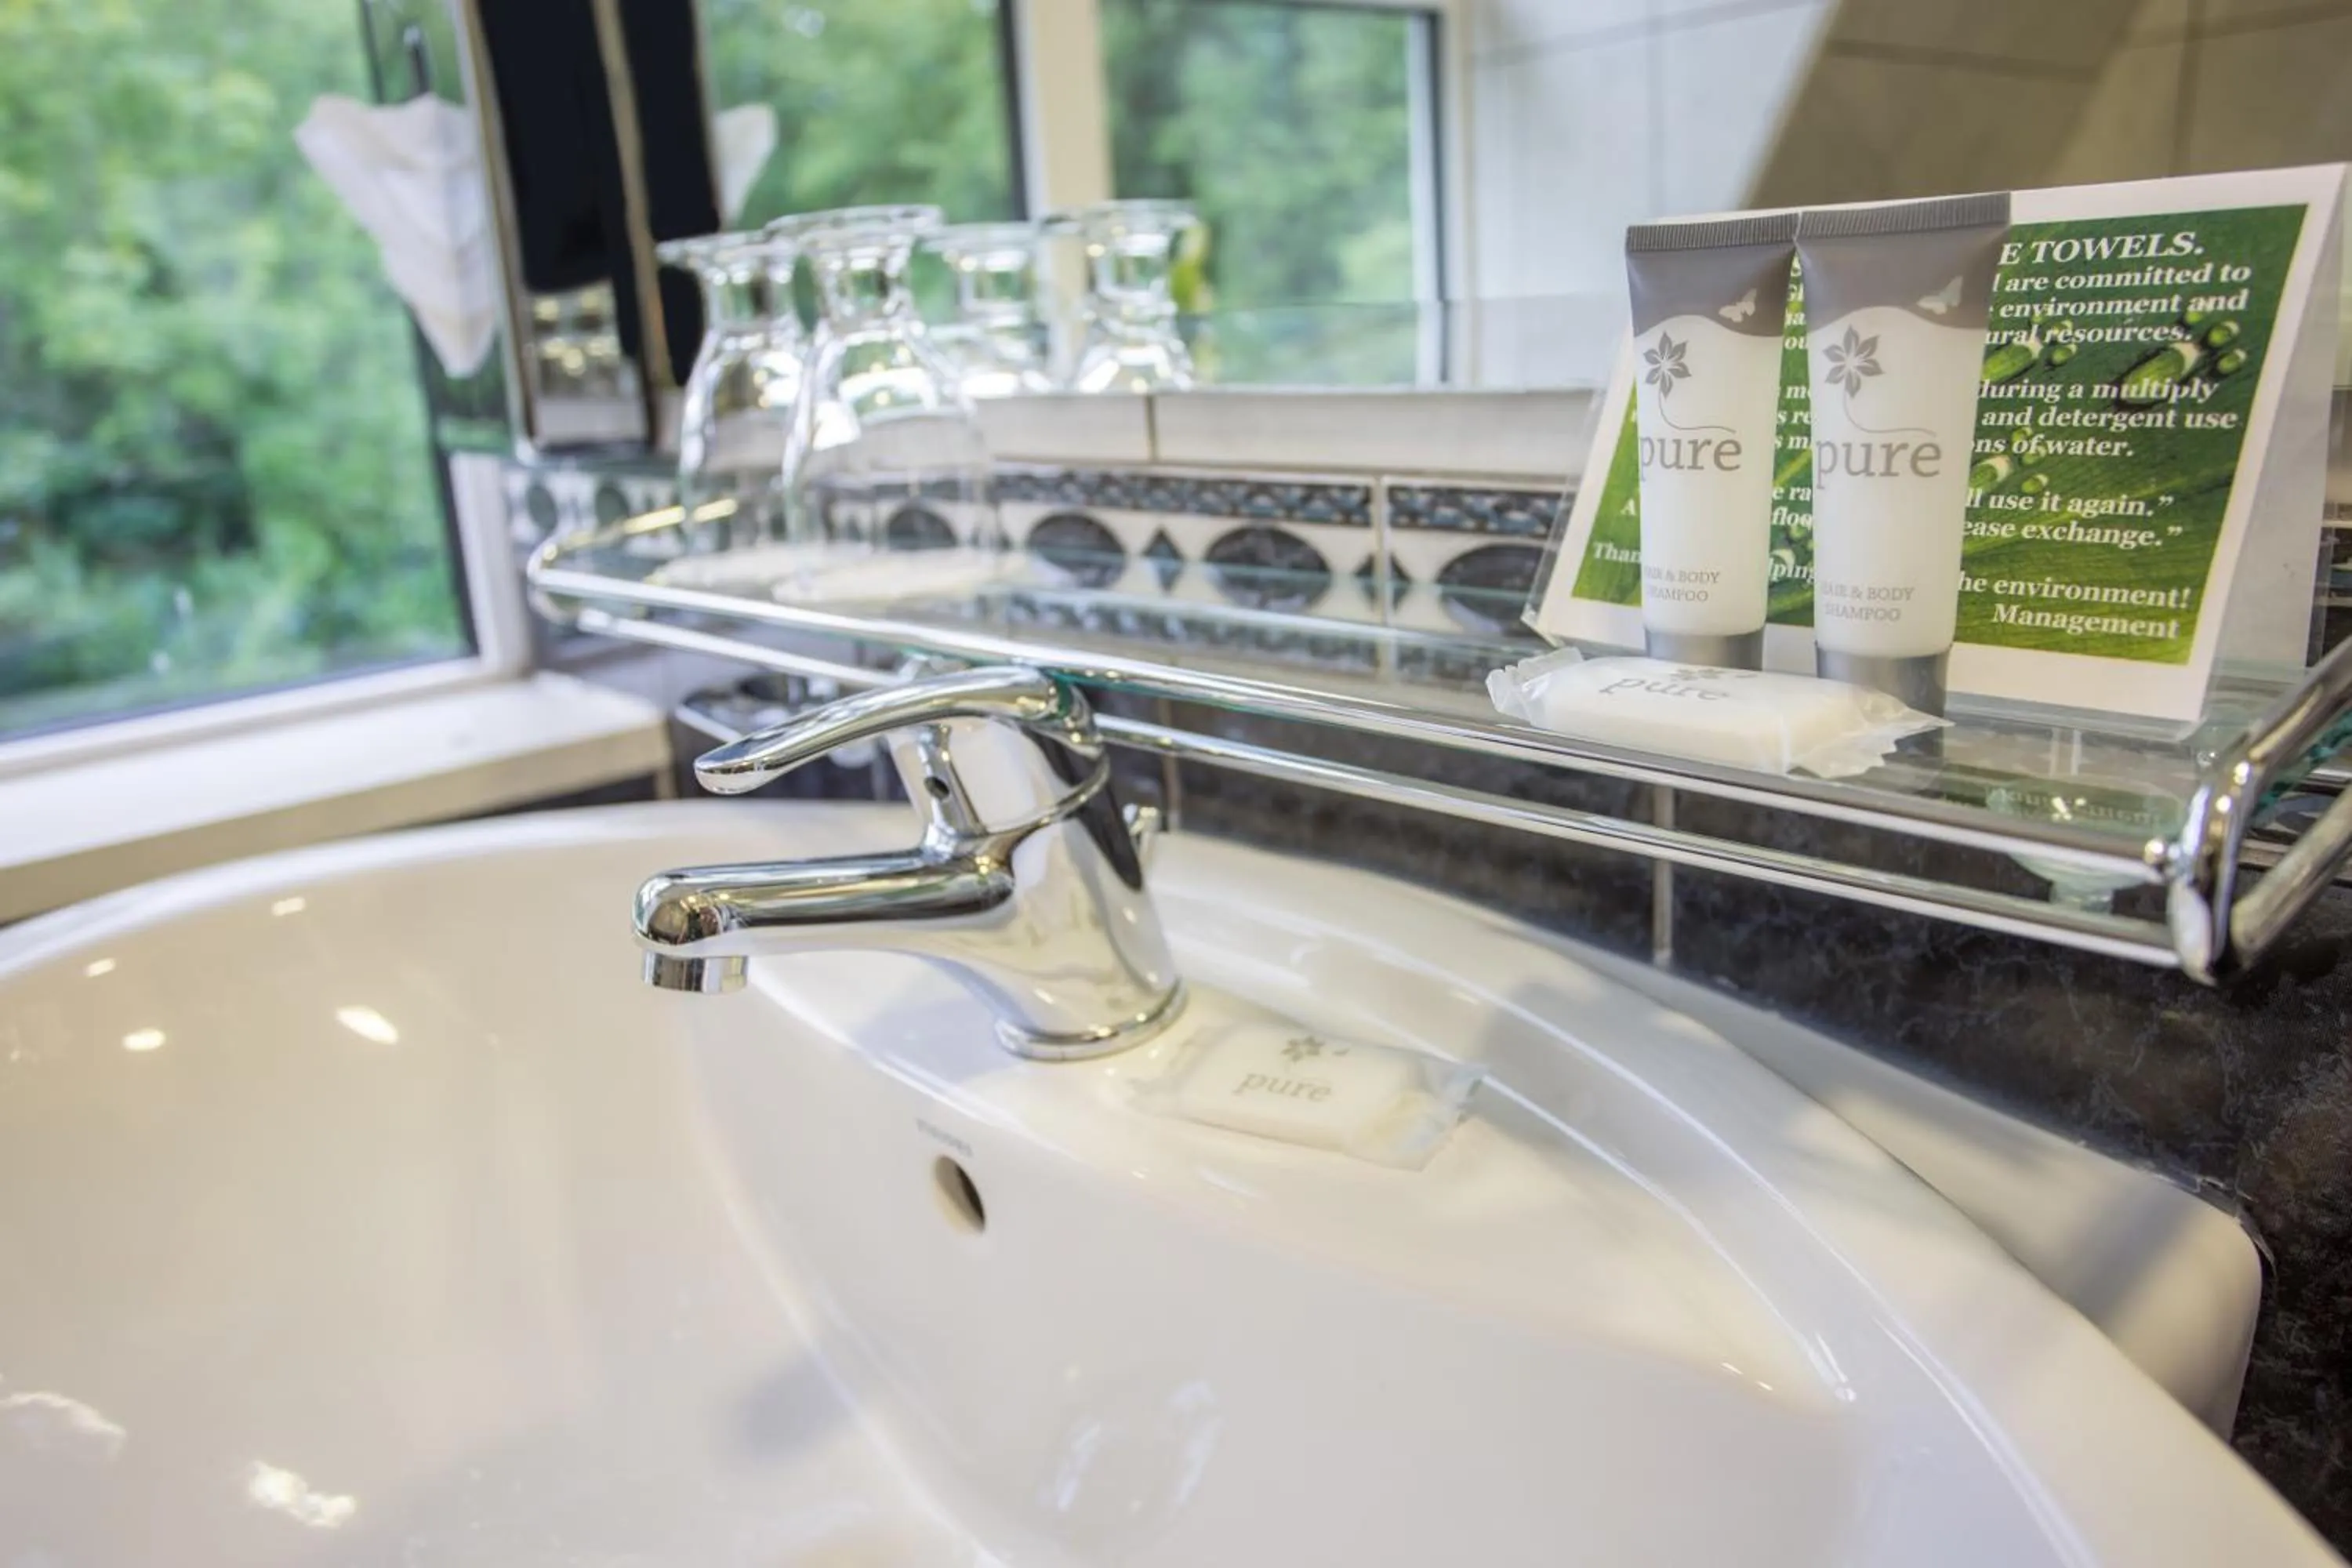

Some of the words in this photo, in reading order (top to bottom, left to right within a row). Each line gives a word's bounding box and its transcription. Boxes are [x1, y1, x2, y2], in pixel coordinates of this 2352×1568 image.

[2031, 231, 2205, 262] TOWELS.
[2005, 275, 2049, 292] are
[2055, 262, 2213, 290] committed
[2220, 263, 2252, 283] to
[2000, 294, 2182, 318] environment
[2187, 288, 2249, 313] and
[2045, 324, 2194, 344] resources.
[2067, 384, 2083, 398] a
[2092, 377, 2219, 404] multiply
[1981, 406, 2034, 426] and
[2038, 406, 2176, 432] detergent
[2184, 412, 2238, 429] use
[1640, 437, 1742, 481] pure
[2013, 434, 2045, 455] of
[2046, 437, 2134, 457] water.
[1816, 441, 1941, 489] pure
[1989, 494, 2033, 510] use
[2041, 492, 2062, 511] it
[1679, 570, 1720, 584] BODY
[1867, 586, 1915, 602] BODY
[1994, 576, 2191, 608] environment!
[1824, 602, 1901, 622] SHAMPOO
[1992, 603, 2180, 639] Management
[1599, 677, 1730, 701] pure
[1231, 1073, 1332, 1102] pure
